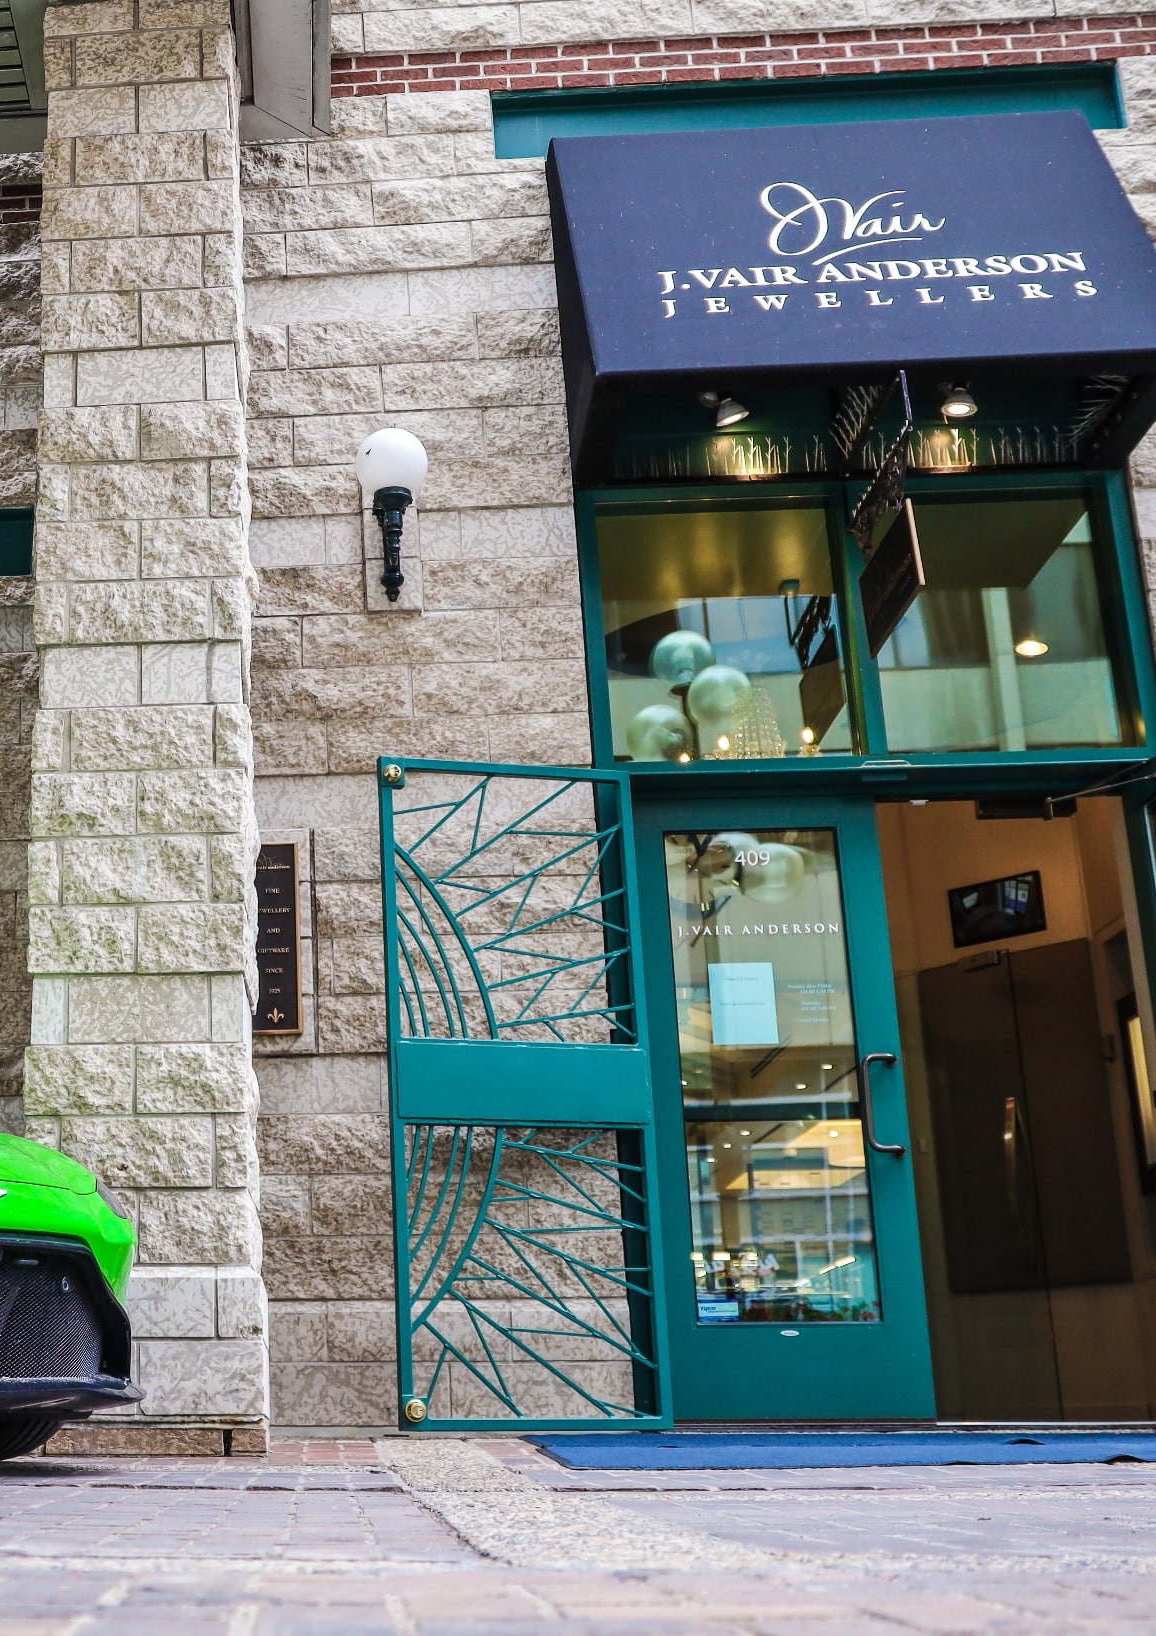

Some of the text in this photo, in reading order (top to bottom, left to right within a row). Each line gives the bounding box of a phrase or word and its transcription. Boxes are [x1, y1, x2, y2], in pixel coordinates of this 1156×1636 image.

[657, 251, 1087, 295] J.VAIR ANDERSON
[661, 281, 1098, 319] JEWELLERS
[734, 850, 771, 867] 409
[677, 923, 840, 938] J.VAIR ANDERSON
